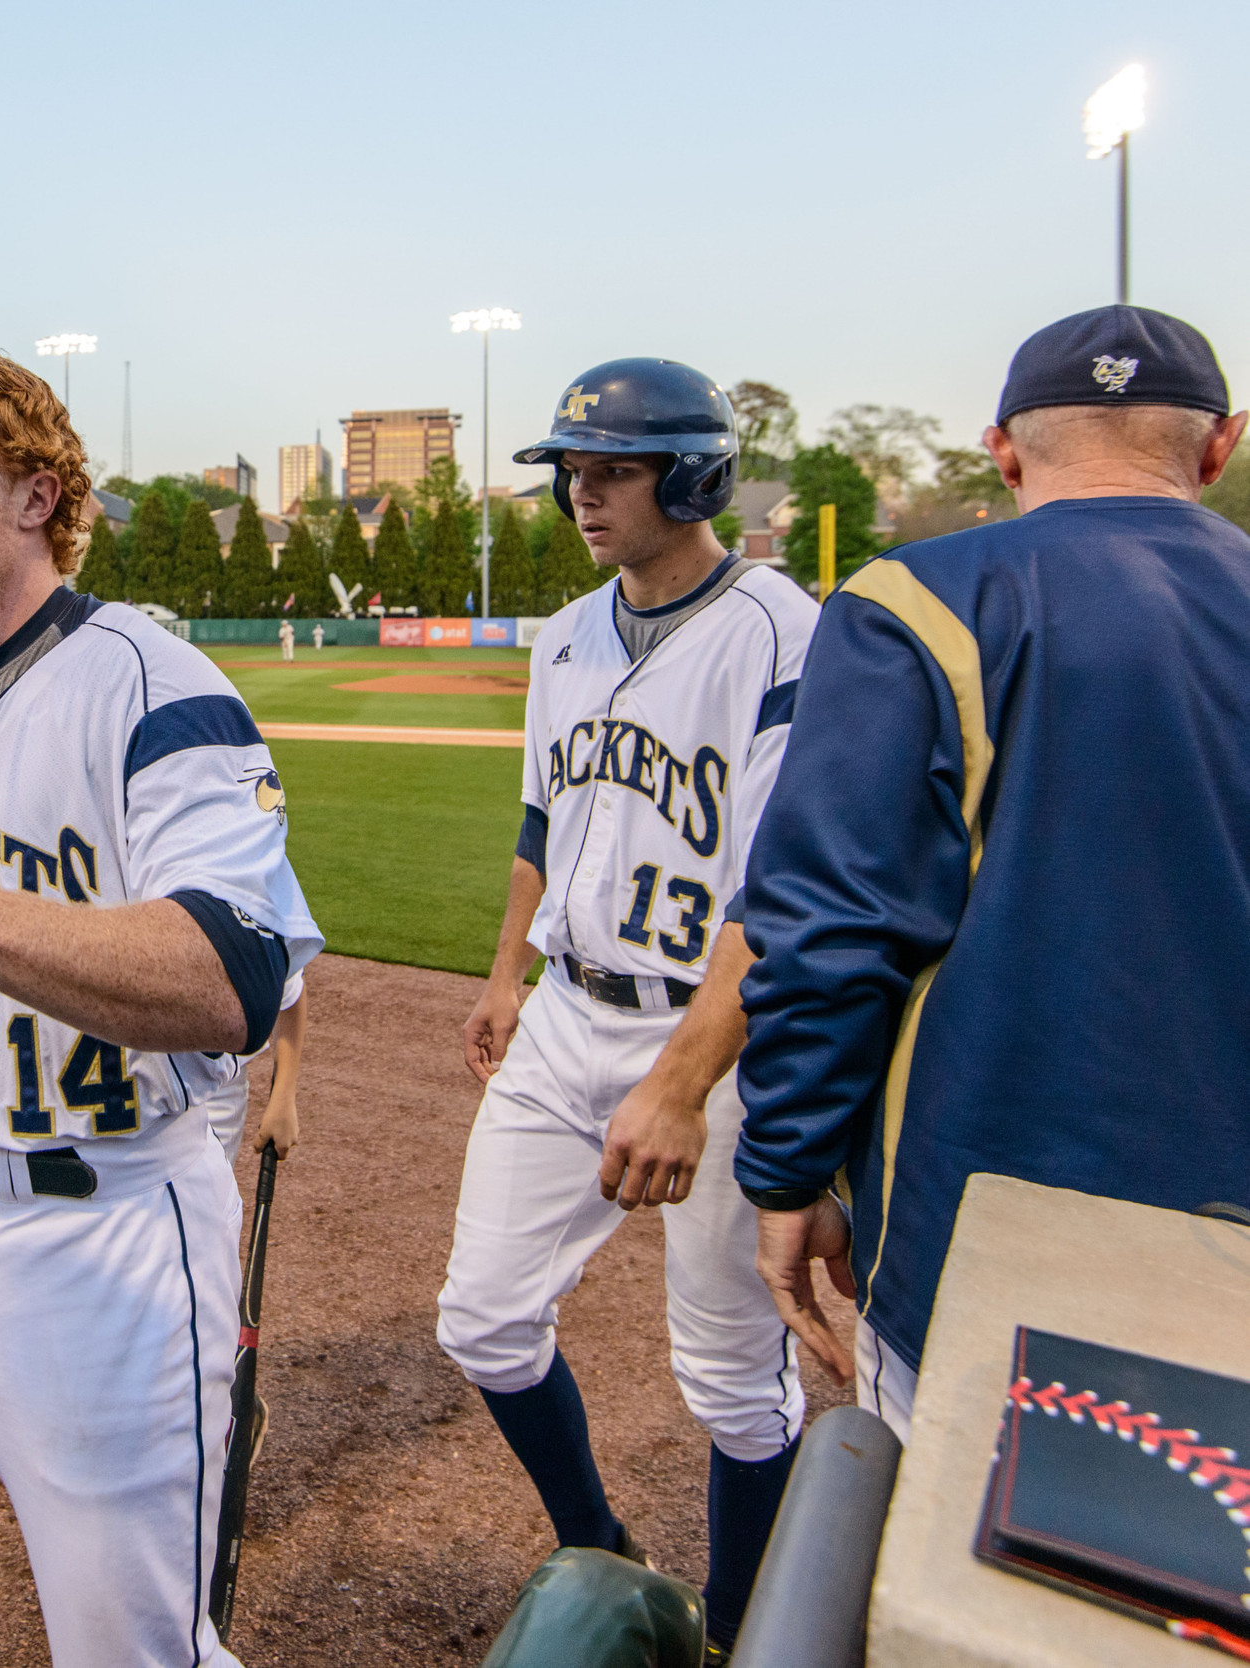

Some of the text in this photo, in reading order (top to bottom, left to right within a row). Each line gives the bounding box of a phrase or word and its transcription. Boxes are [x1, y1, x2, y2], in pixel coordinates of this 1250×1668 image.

[557, 384, 601, 422] GT
[547, 717, 729, 859] ACKETS
[617, 861, 716, 966] 13
[6, 1013, 140, 1139] 14
